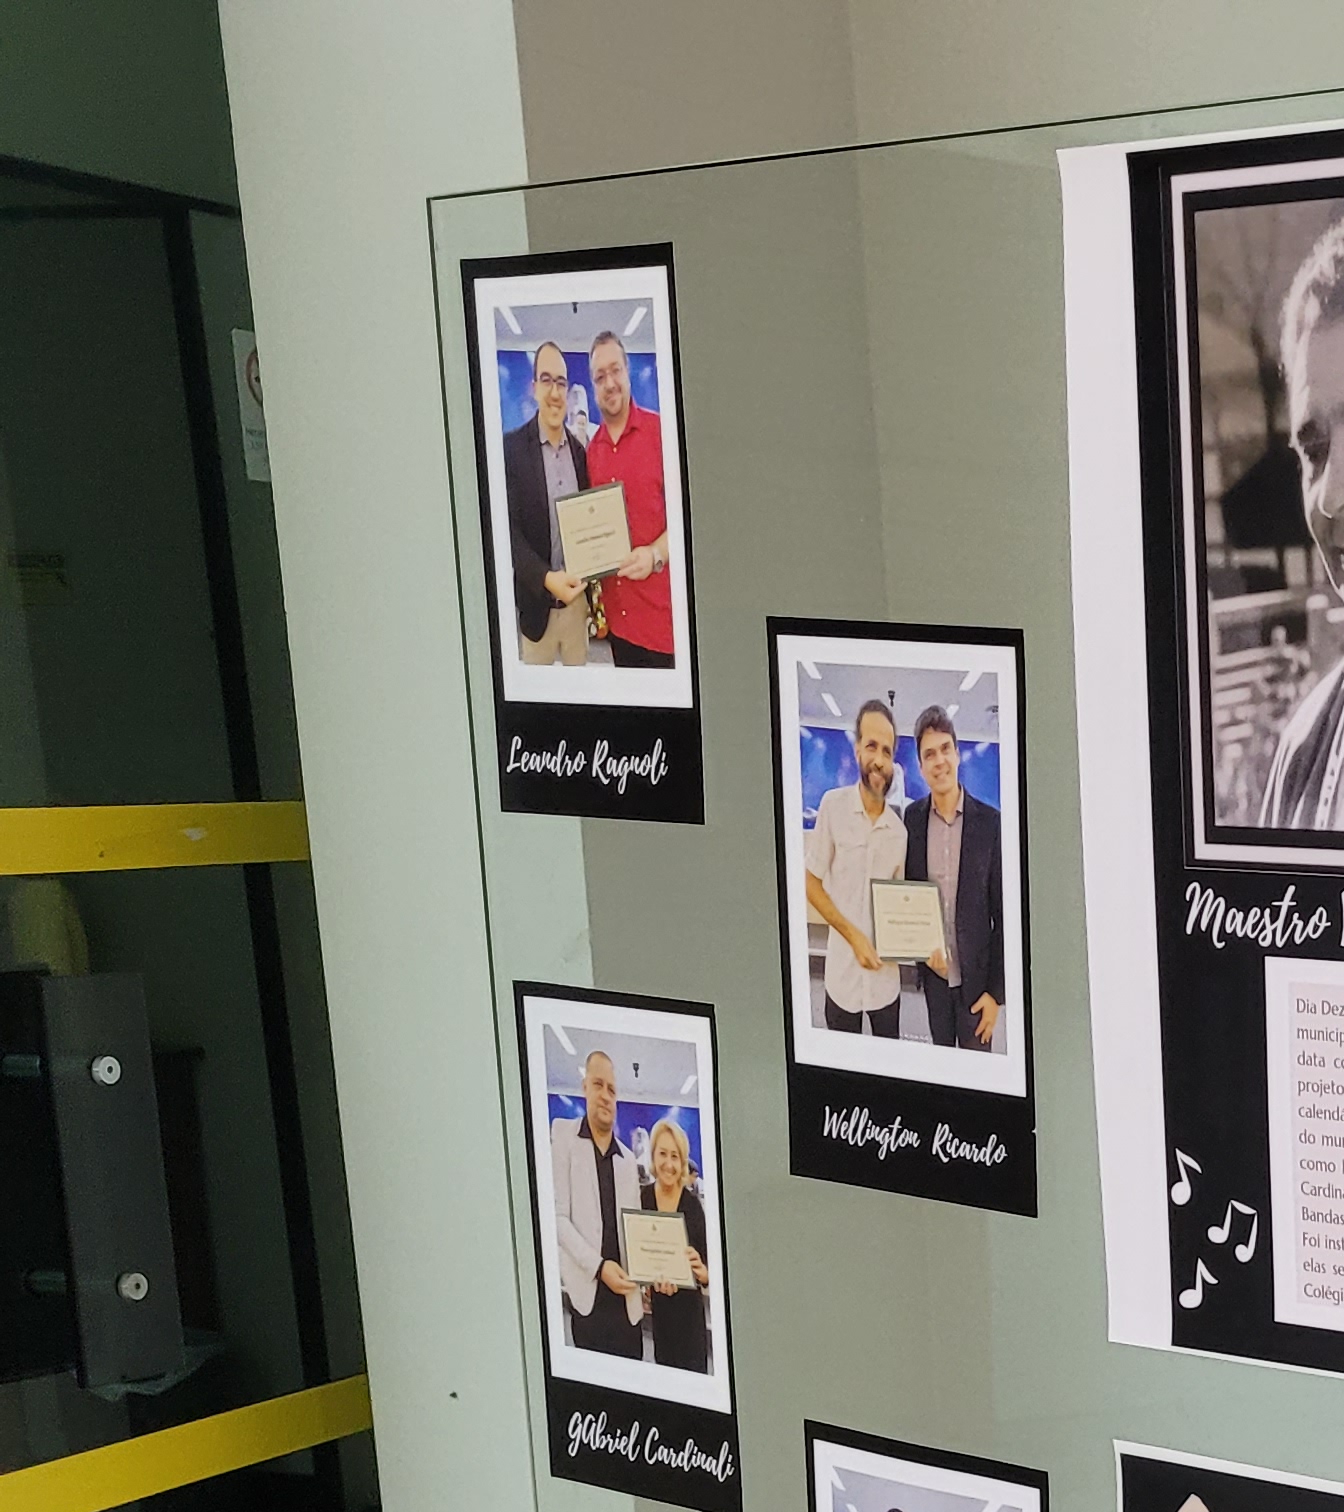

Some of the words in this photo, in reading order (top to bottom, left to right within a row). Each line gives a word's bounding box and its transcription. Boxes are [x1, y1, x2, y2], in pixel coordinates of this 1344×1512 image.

[506, 736, 587, 777] Leandro
[592, 738, 668, 794] Ragnoli
[1185, 881, 1331, 949] Maestro
[1296, 998, 1317, 1014] Dia
[1297, 1050, 1325, 1068] data
[1298, 1079, 1344, 1097] projeto
[823, 1105, 921, 1160] Wellington
[932, 1122, 1008, 1166] Ricardo
[1299, 1129, 1316, 1144] do
[1300, 1158, 1336, 1173] como
[1301, 1206, 1344, 1225] Bandas
[1303, 1232, 1320, 1248] Foi
[1303, 1258, 1326, 1274] elas
[1333, 1264, 1344, 1276] se
[644, 1427, 735, 1482] Cardinali
